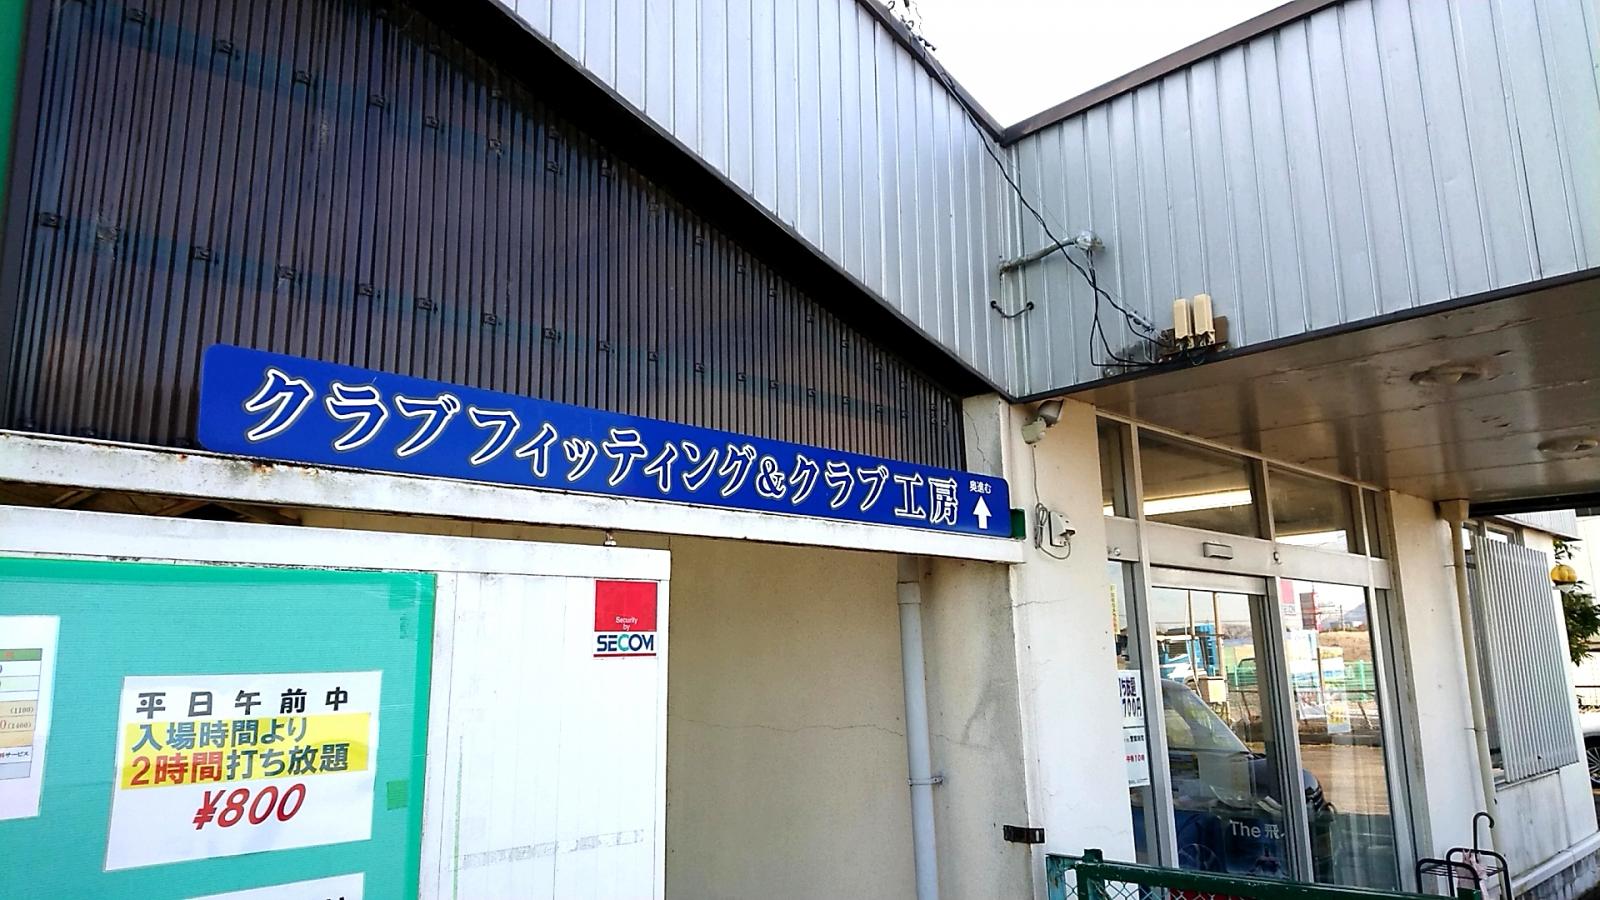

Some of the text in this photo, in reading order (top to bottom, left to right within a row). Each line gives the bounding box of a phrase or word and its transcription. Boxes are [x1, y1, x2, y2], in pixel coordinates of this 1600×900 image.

[969, 480, 992, 495] 奥進む
[615, 616, 638, 625] Security
[622, 623, 631, 631] by
[597, 633, 654, 651] SECOM
[135, 686, 349, 719] 平日午前中
[131, 718, 308, 752] 入場時間より
[130, 743, 350, 786] 2時間打ち放題
[192, 782, 307, 831] ¥800
[1229, 819, 1261, 838] The
